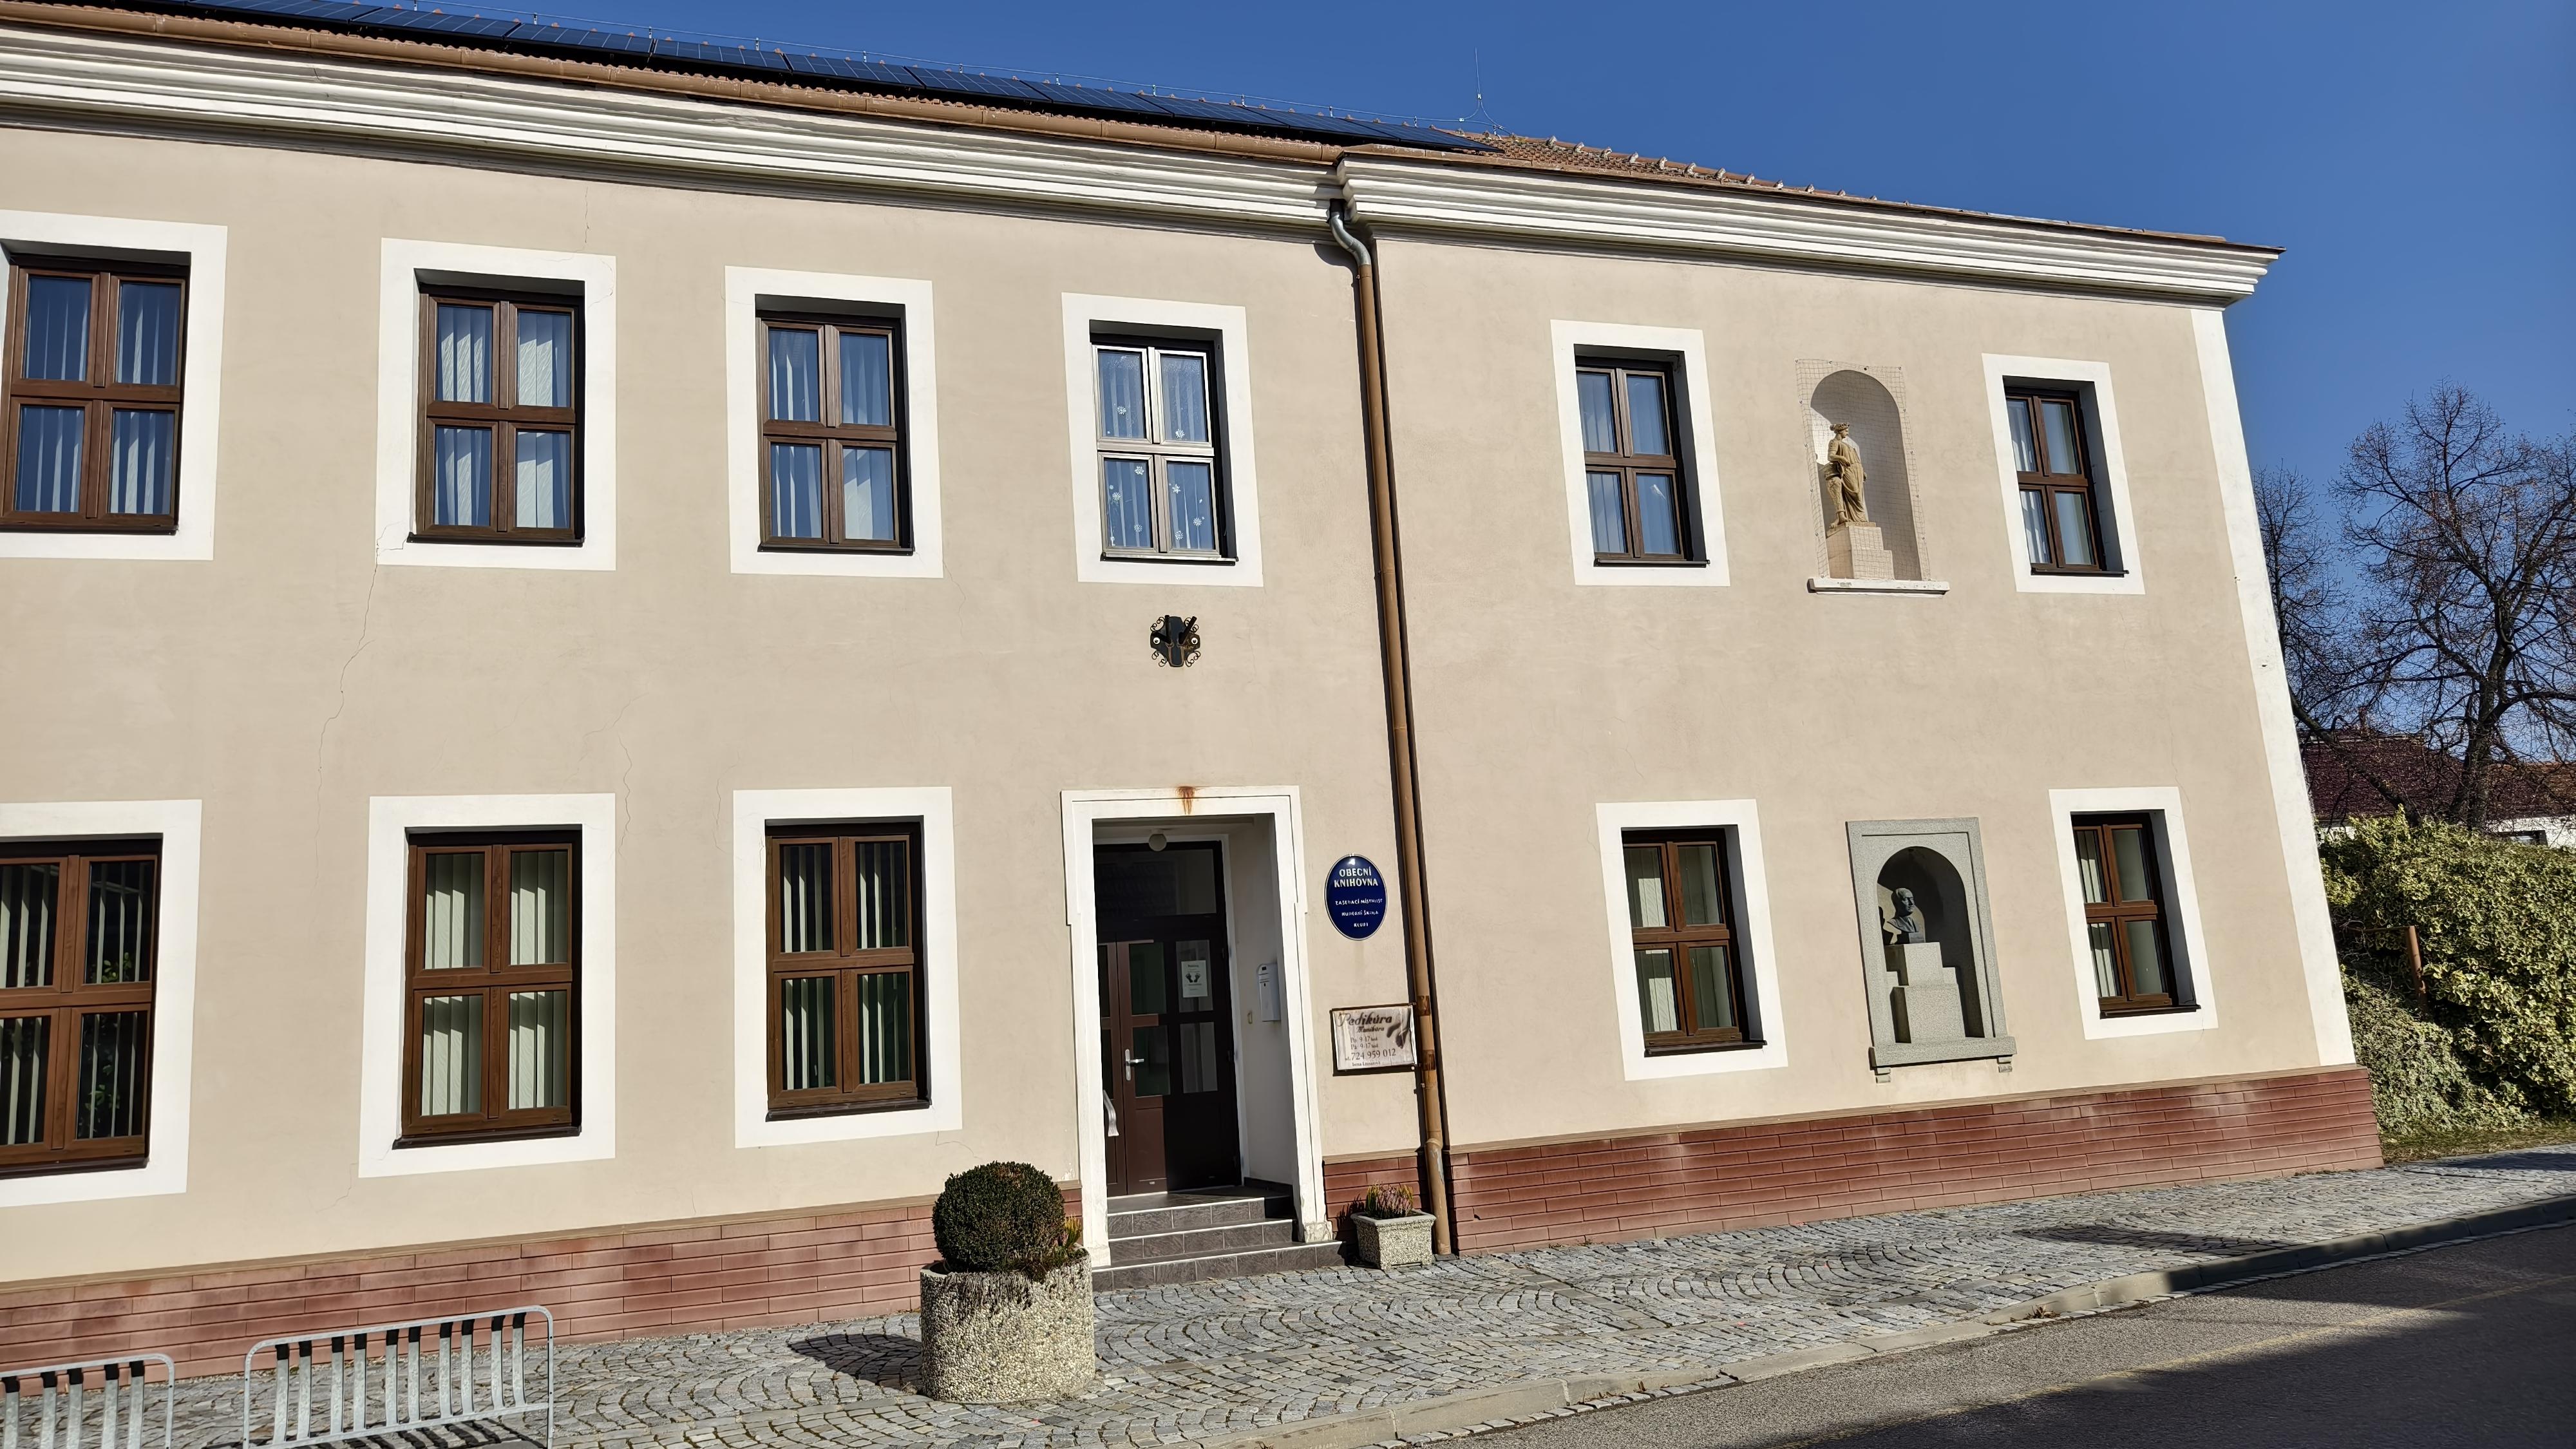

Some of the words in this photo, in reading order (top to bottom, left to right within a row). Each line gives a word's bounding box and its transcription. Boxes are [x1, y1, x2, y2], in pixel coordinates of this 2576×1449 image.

[1339, 866, 1372, 876] OBECNÍ
[1334, 878, 1378, 887] KNIHOVNA
[1337, 1012, 1392, 1027] Pedikúra
[1351, 1052, 1365, 1060] 724
[1383, 1048, 1396, 1057] 012
